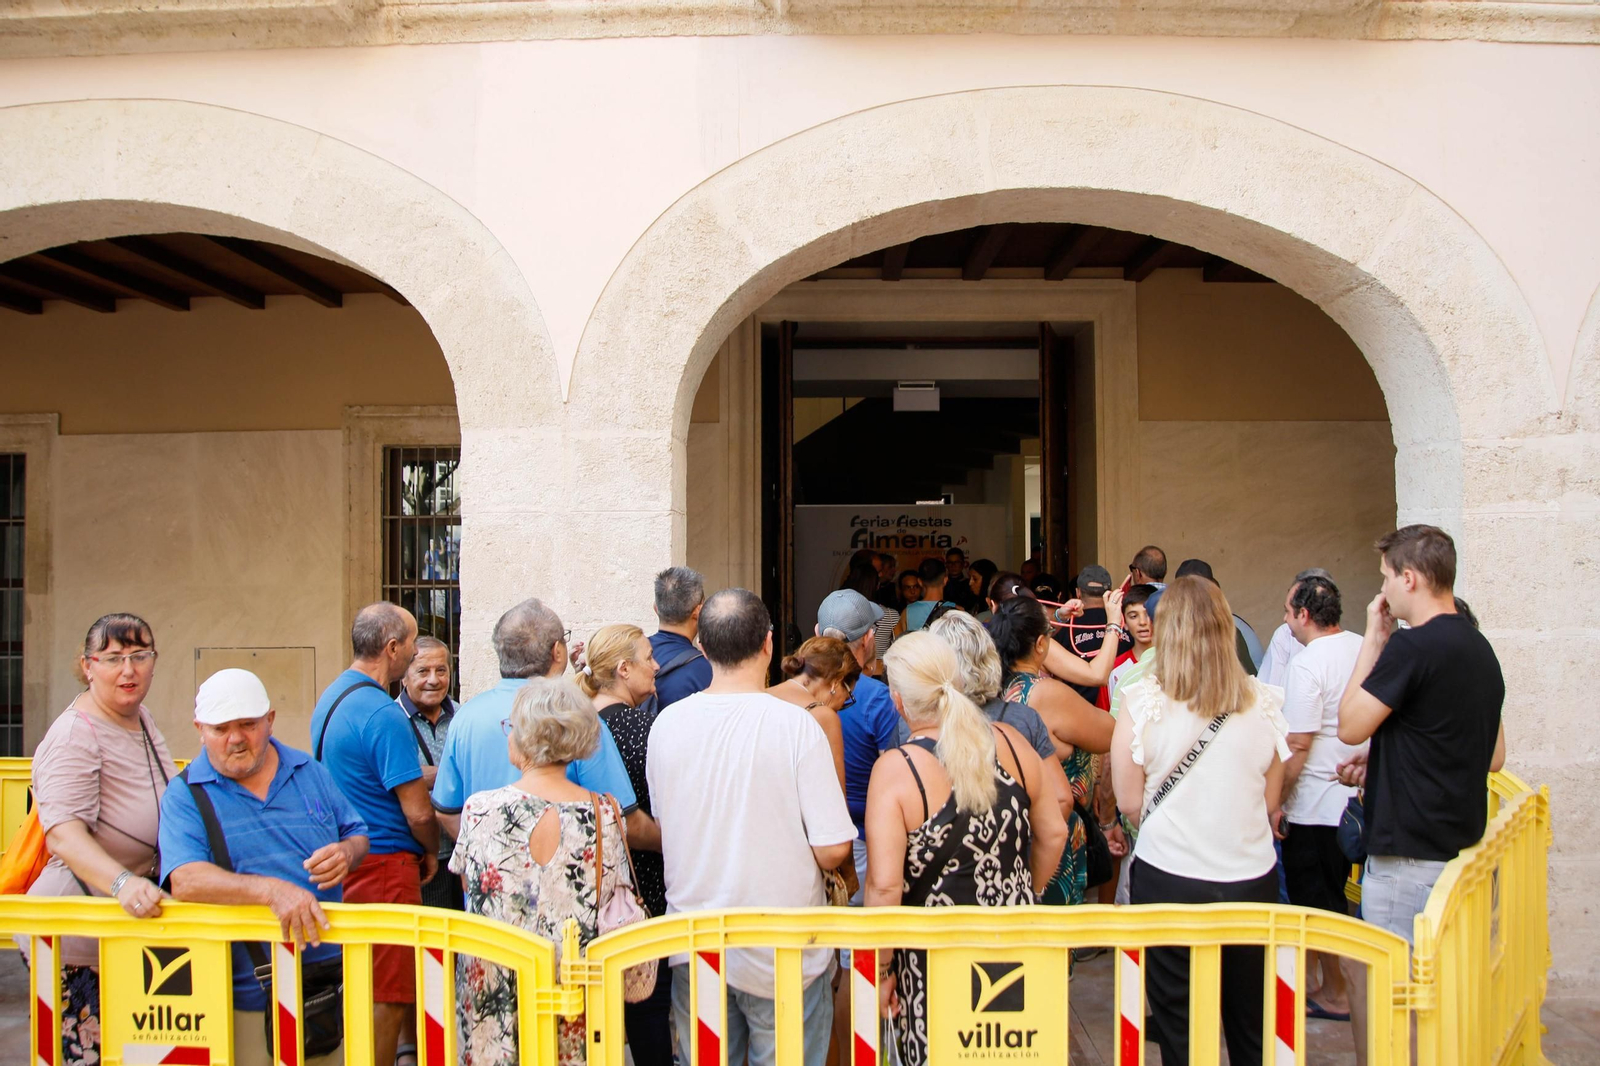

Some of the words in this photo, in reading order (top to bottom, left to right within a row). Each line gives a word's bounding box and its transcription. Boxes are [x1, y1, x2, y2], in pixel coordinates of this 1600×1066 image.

[850, 515, 890, 527] Feria
[896, 515, 952, 527] Fiestas
[851, 528, 952, 549] Almería
[1152, 775, 1179, 806] BIMBA
[1174, 765, 1184, 776] Y
[1181, 739, 1208, 768] LOLA
[132, 1005, 206, 1031] villar
[132, 1033, 207, 1042] señalización
[957, 1022, 1038, 1048] villar
[957, 1050, 1039, 1058] señalización
